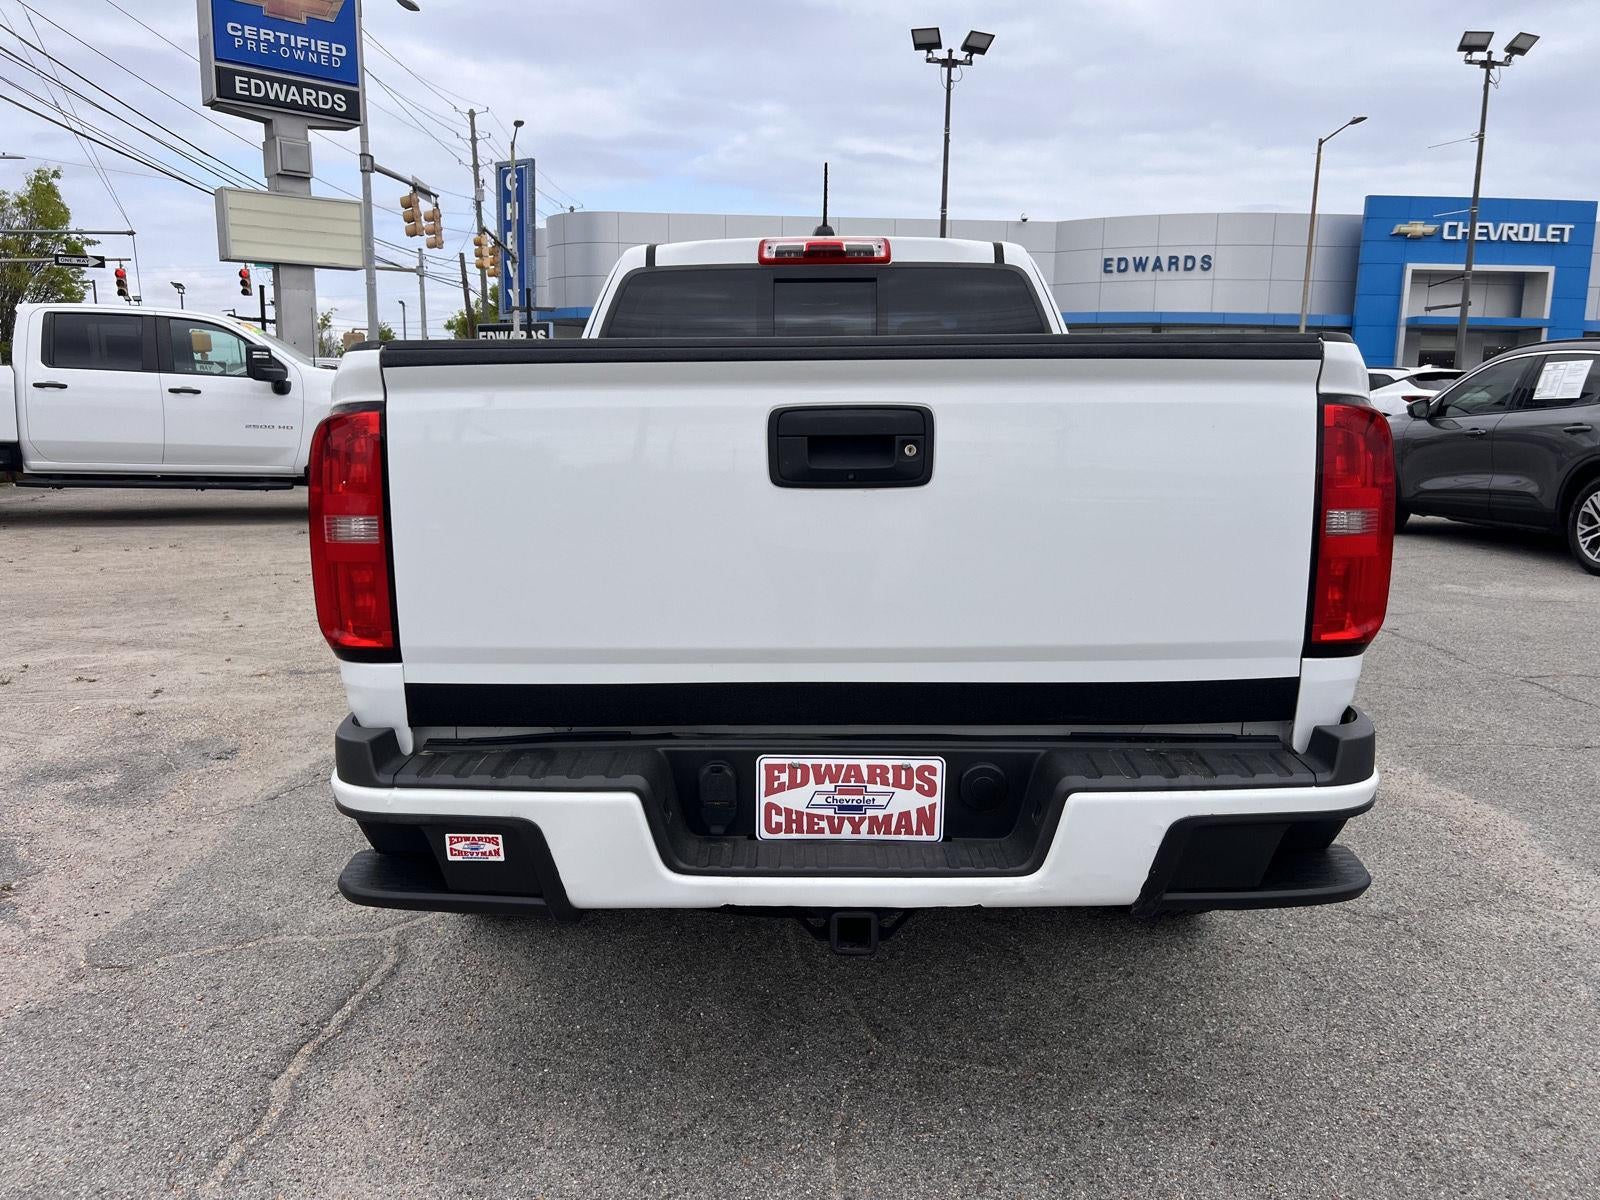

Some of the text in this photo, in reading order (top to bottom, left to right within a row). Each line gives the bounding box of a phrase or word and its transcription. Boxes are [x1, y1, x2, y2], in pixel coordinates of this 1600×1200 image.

[226, 22, 347, 57] CERTIFIED
[234, 38, 341, 68] PRE-OWNED
[234, 76, 347, 112] EDWARDS
[1442, 221, 1575, 243] CHEVROLET
[1103, 254, 1212, 274] EDWARDS
[764, 763, 938, 798] EDWARDS
[825, 795, 876, 805] Chevrolet
[764, 801, 937, 836] CHEVYMAN
[448, 836, 500, 847] EDWARDS
[449, 847, 501, 857] CHEVYMAN
